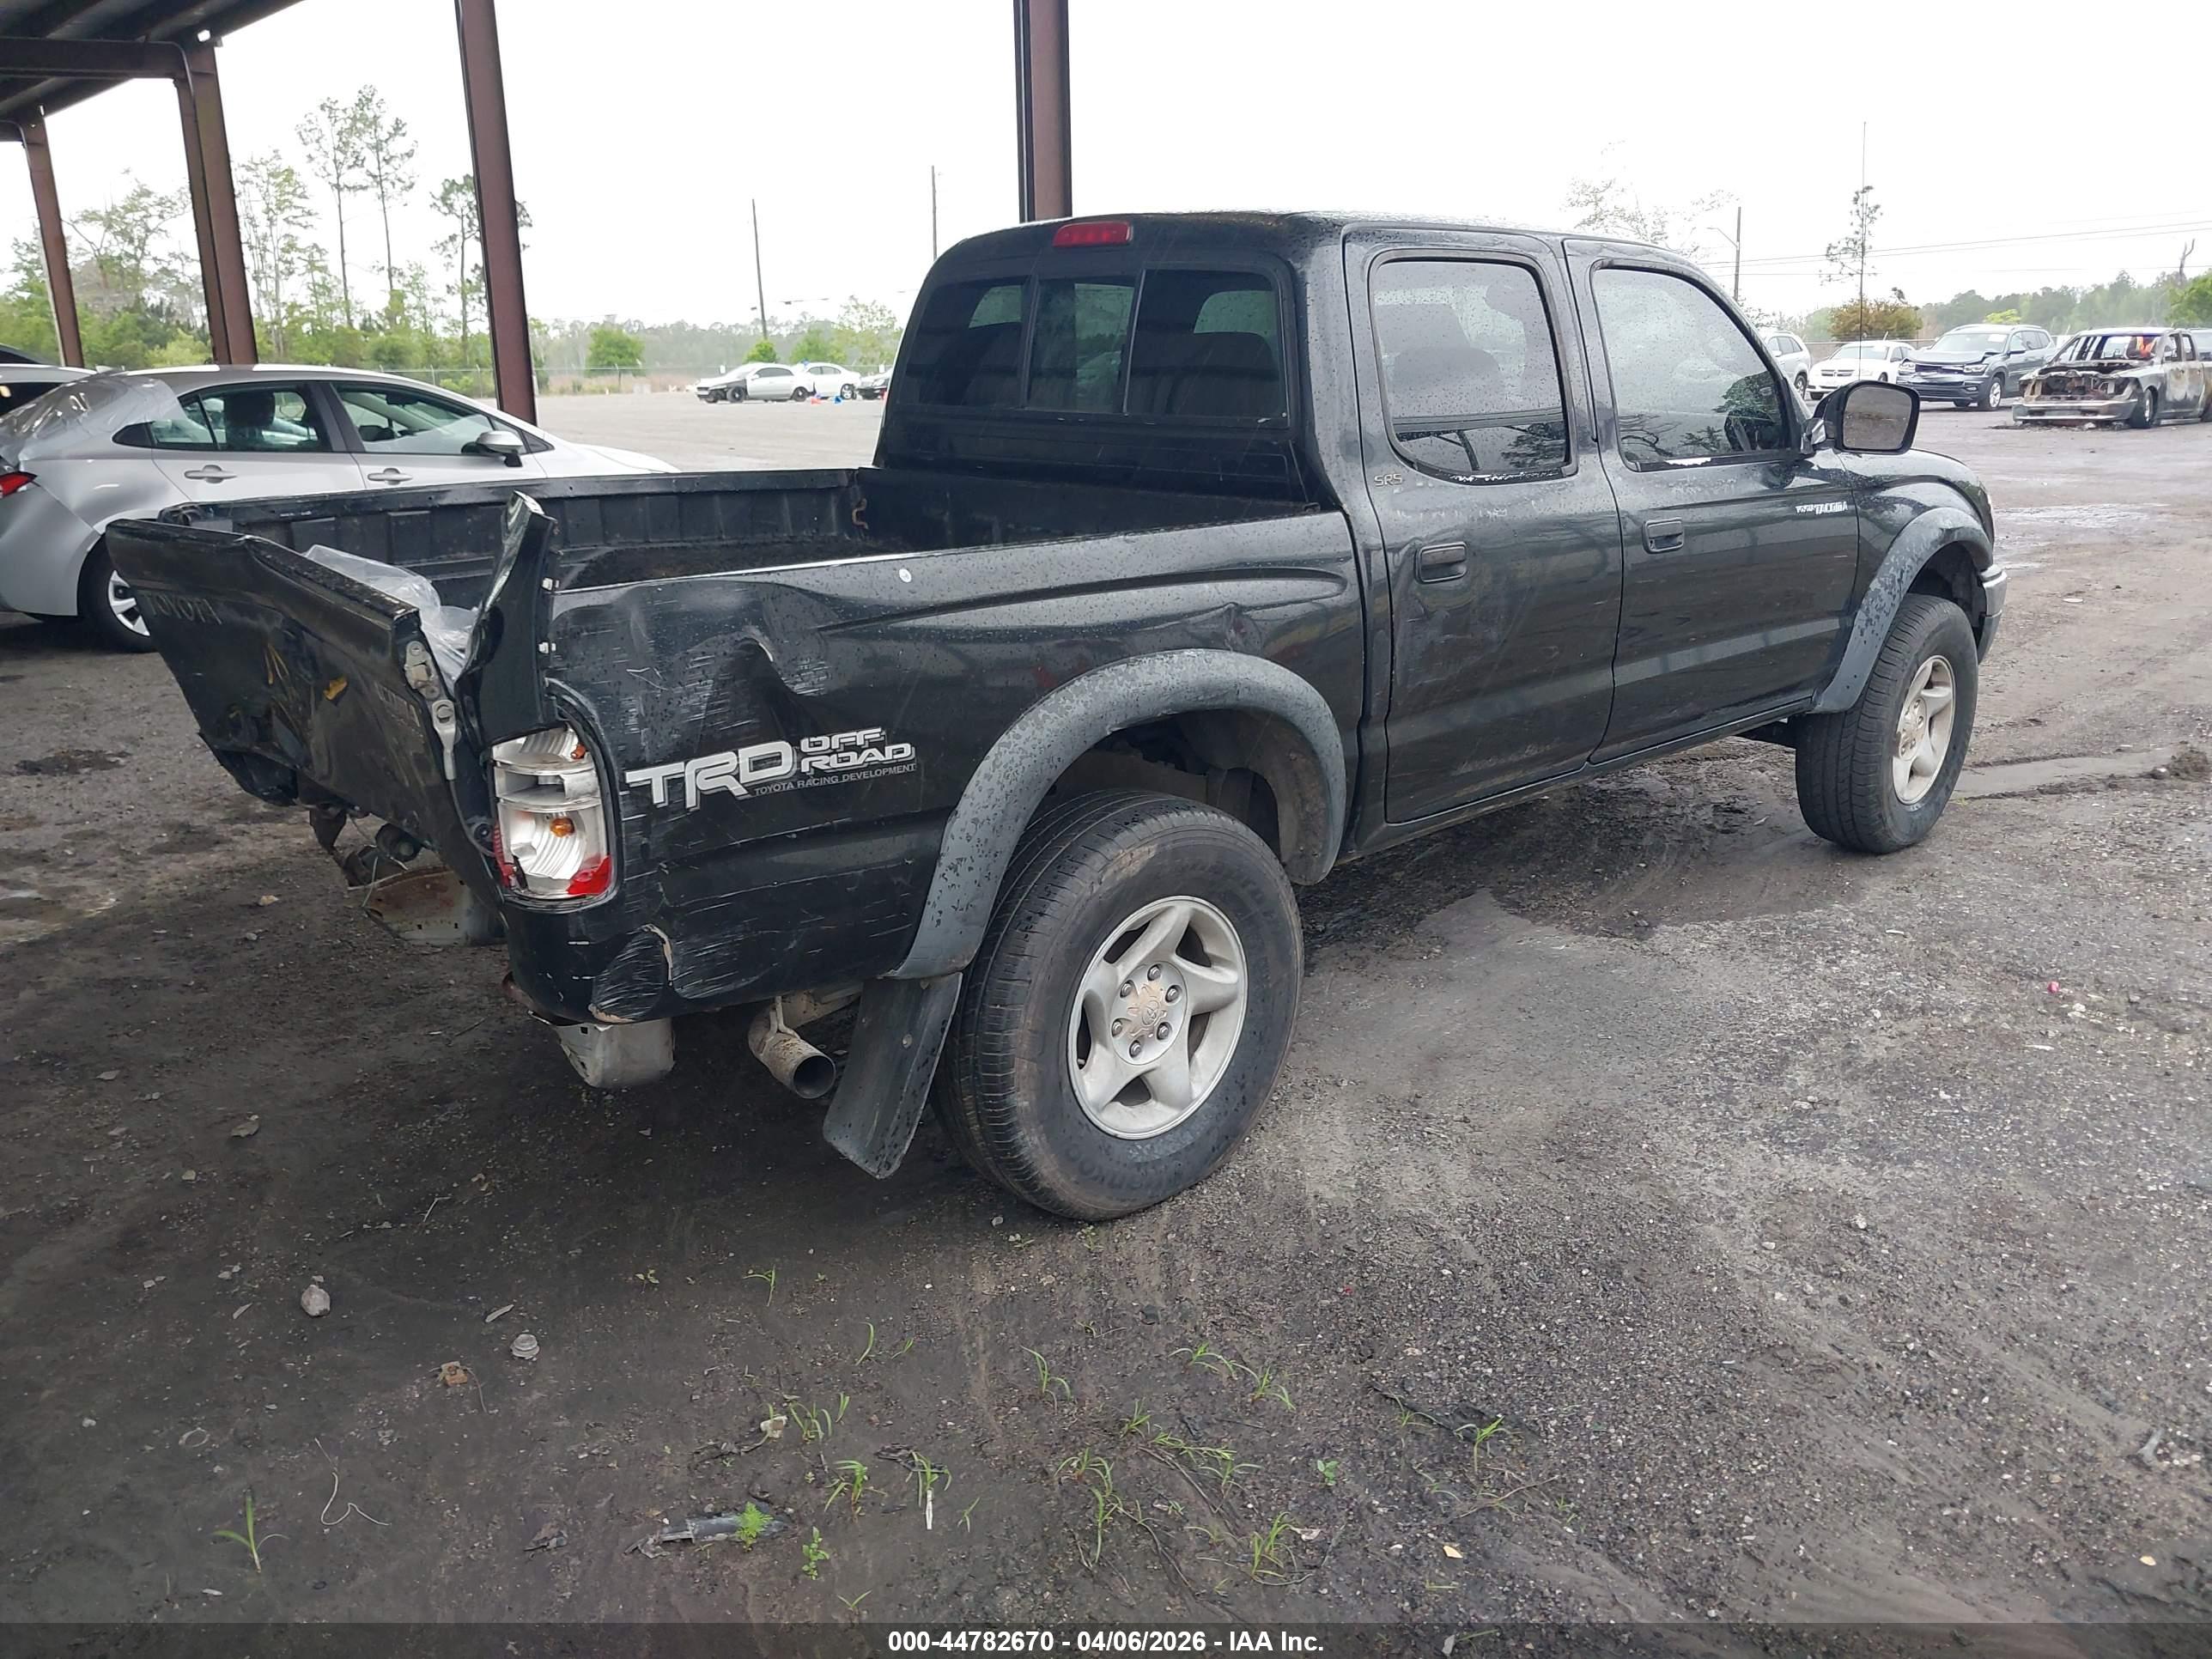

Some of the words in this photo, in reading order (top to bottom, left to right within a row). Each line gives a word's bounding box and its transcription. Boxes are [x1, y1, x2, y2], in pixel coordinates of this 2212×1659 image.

[799, 726, 886, 754] OFF
[625, 740, 796, 811] TRD
[799, 742, 915, 775] ROAD
[754, 780, 795, 797] TOYOTA
[796, 773, 840, 789] RACING
[841, 761, 917, 782] DEVELOPMENT
